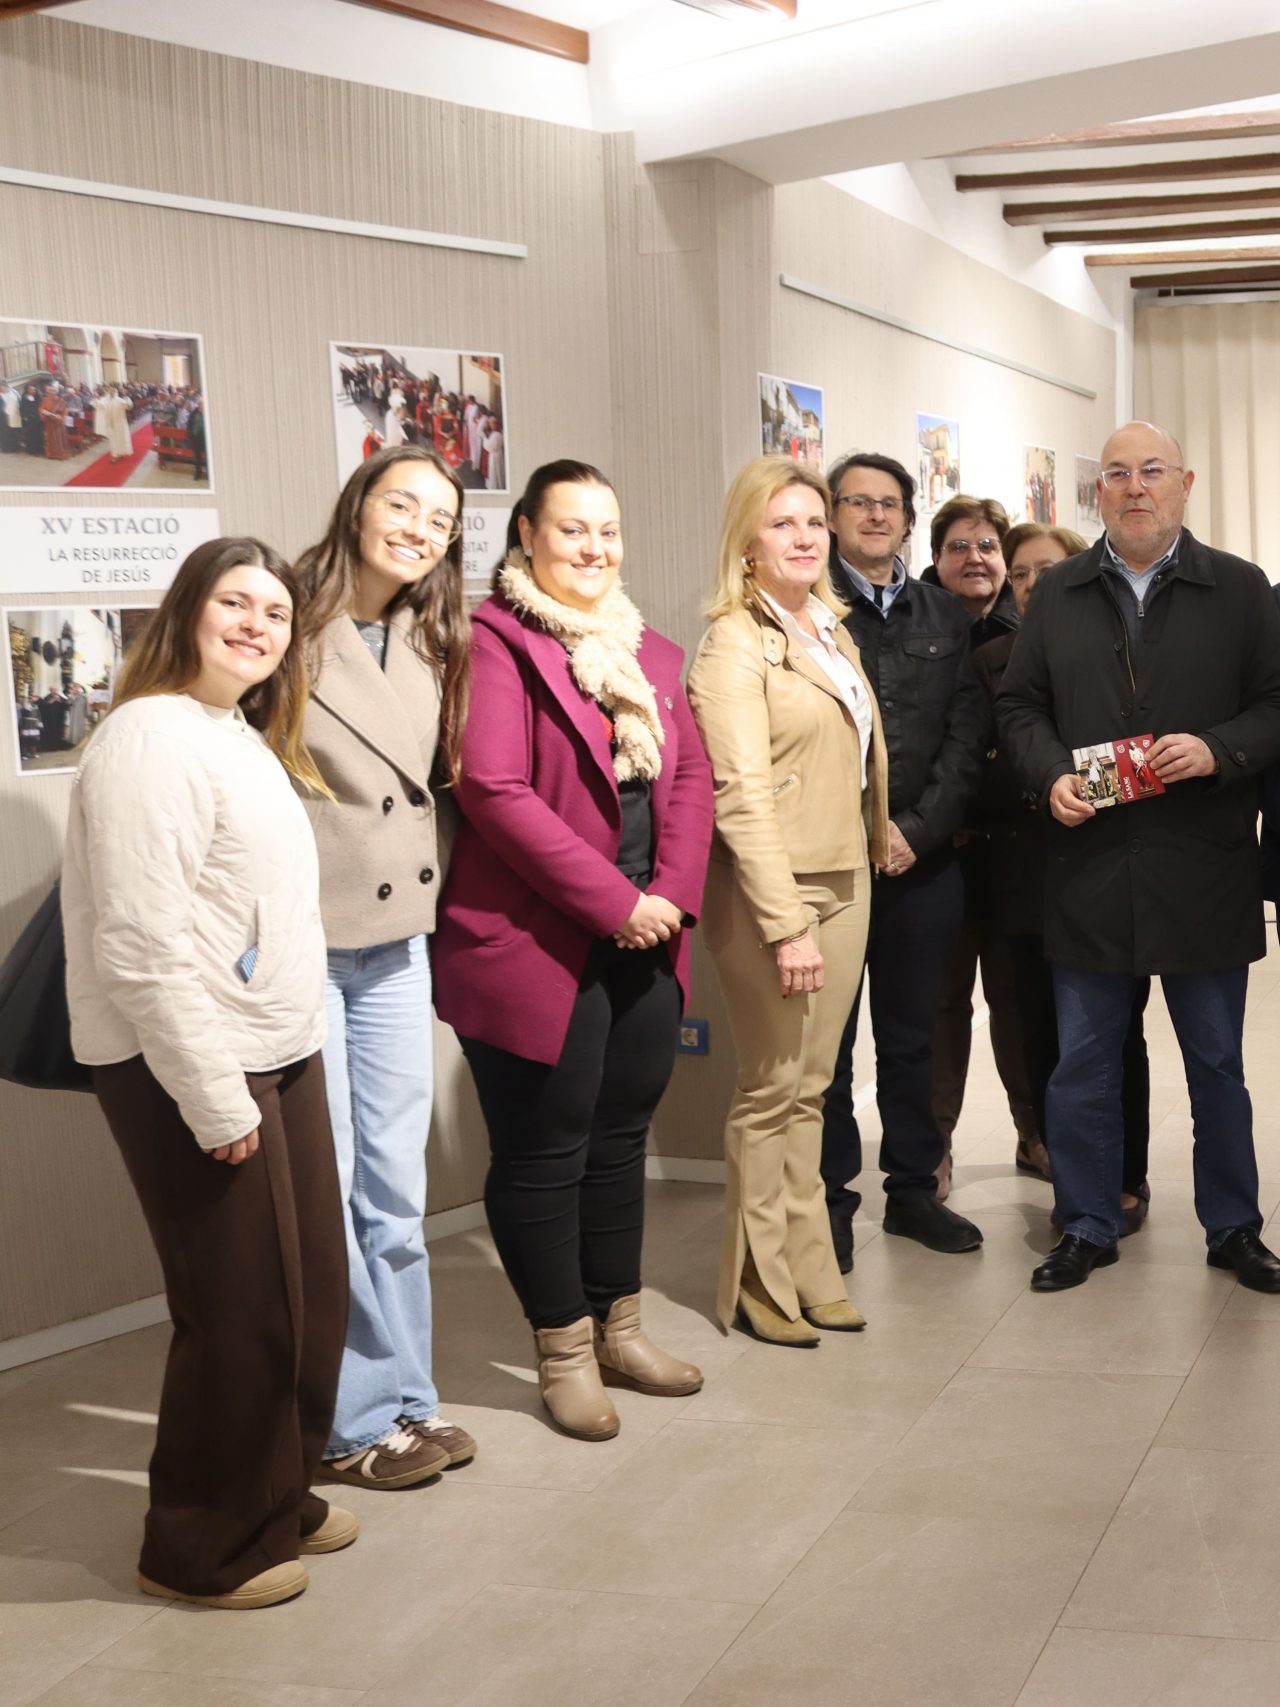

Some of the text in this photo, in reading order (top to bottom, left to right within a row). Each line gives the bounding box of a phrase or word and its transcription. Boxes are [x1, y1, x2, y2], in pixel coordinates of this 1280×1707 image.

[41, 513, 180, 535] XV ESTACIÓ
[49, 548, 69, 562] LA
[82, 565, 151, 583] DE JESÚS
